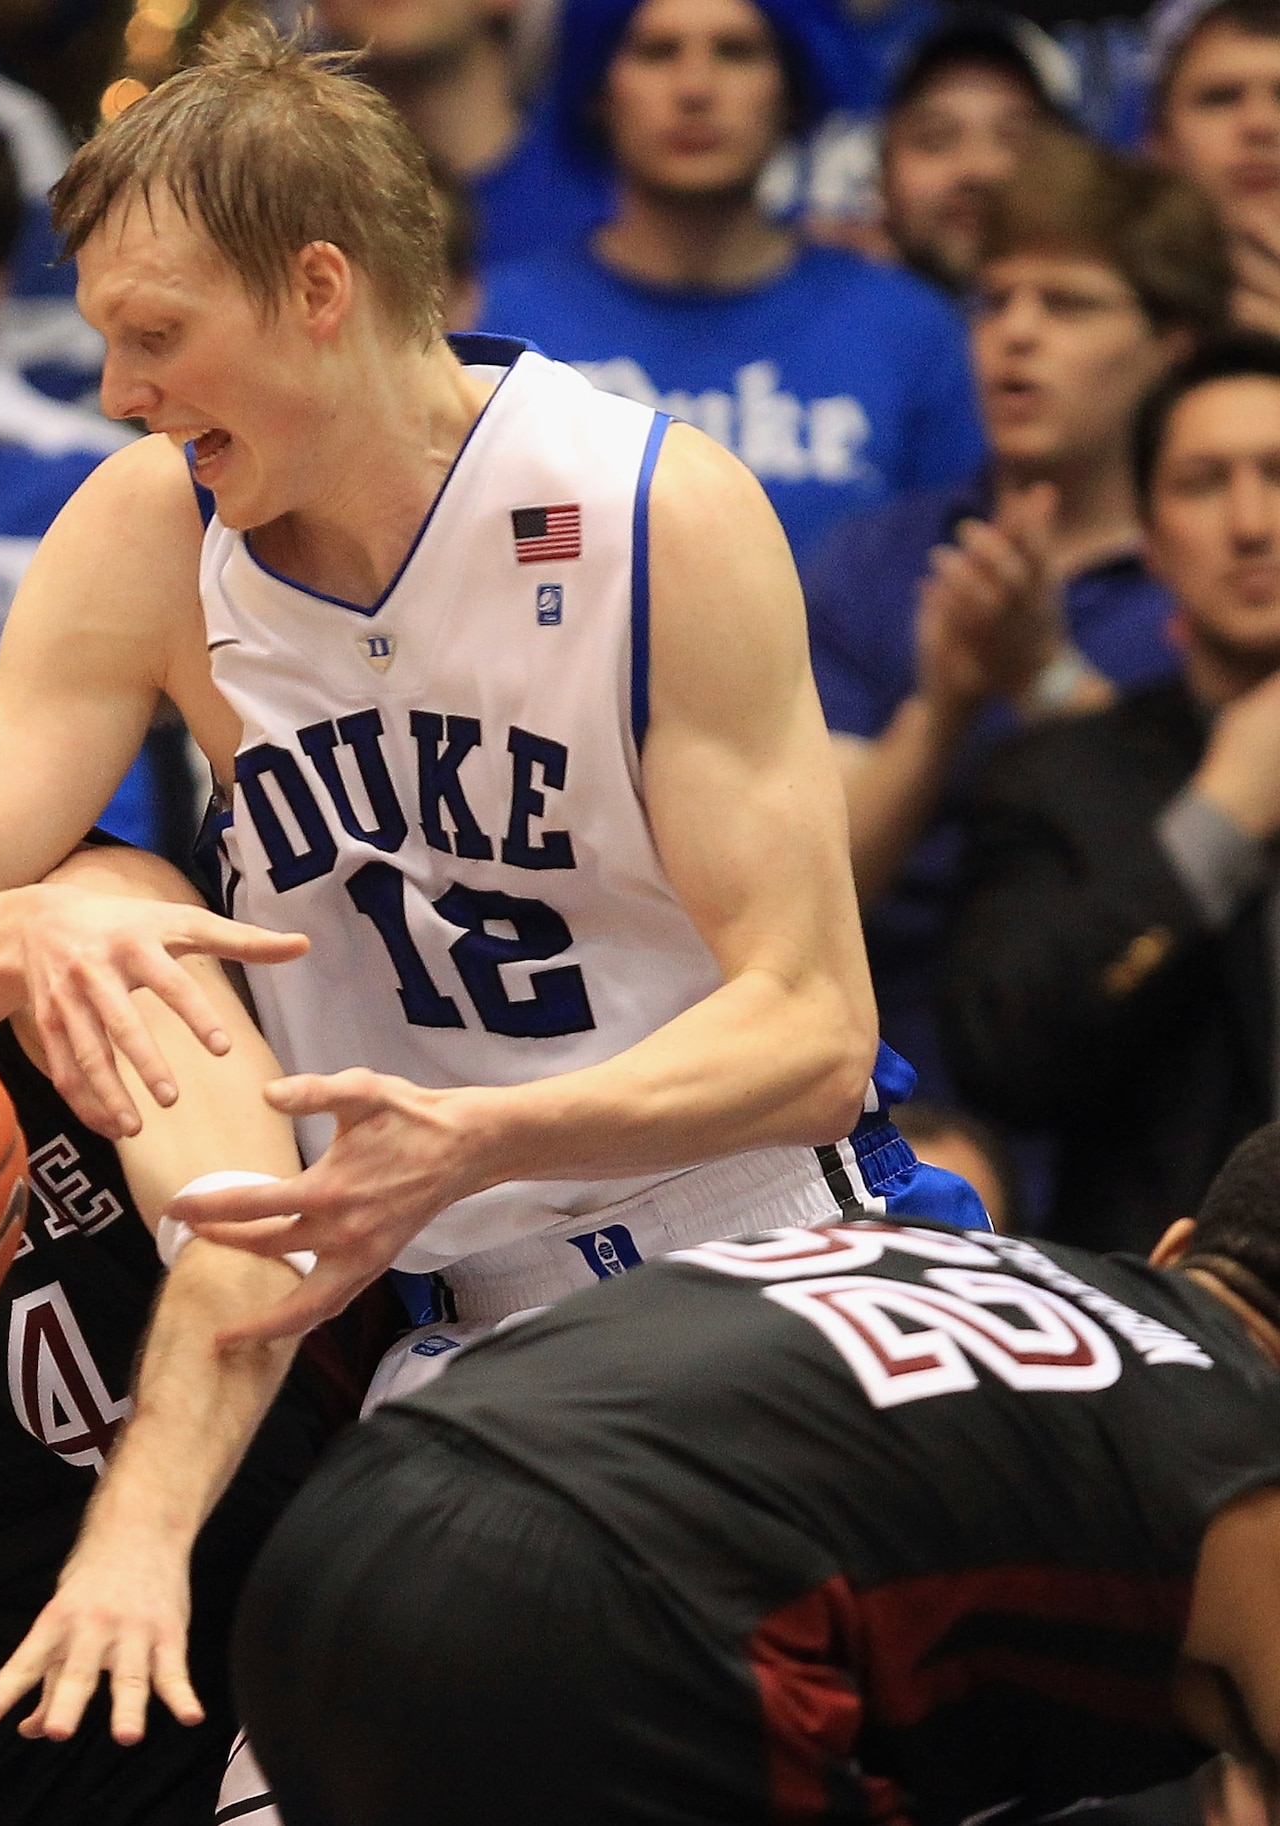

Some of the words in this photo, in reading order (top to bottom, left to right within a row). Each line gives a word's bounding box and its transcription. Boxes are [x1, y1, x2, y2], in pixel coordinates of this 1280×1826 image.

[234, 707, 577, 894] DUKE
[344, 860, 597, 1039] 12
[7, 1279, 138, 1478] 4
